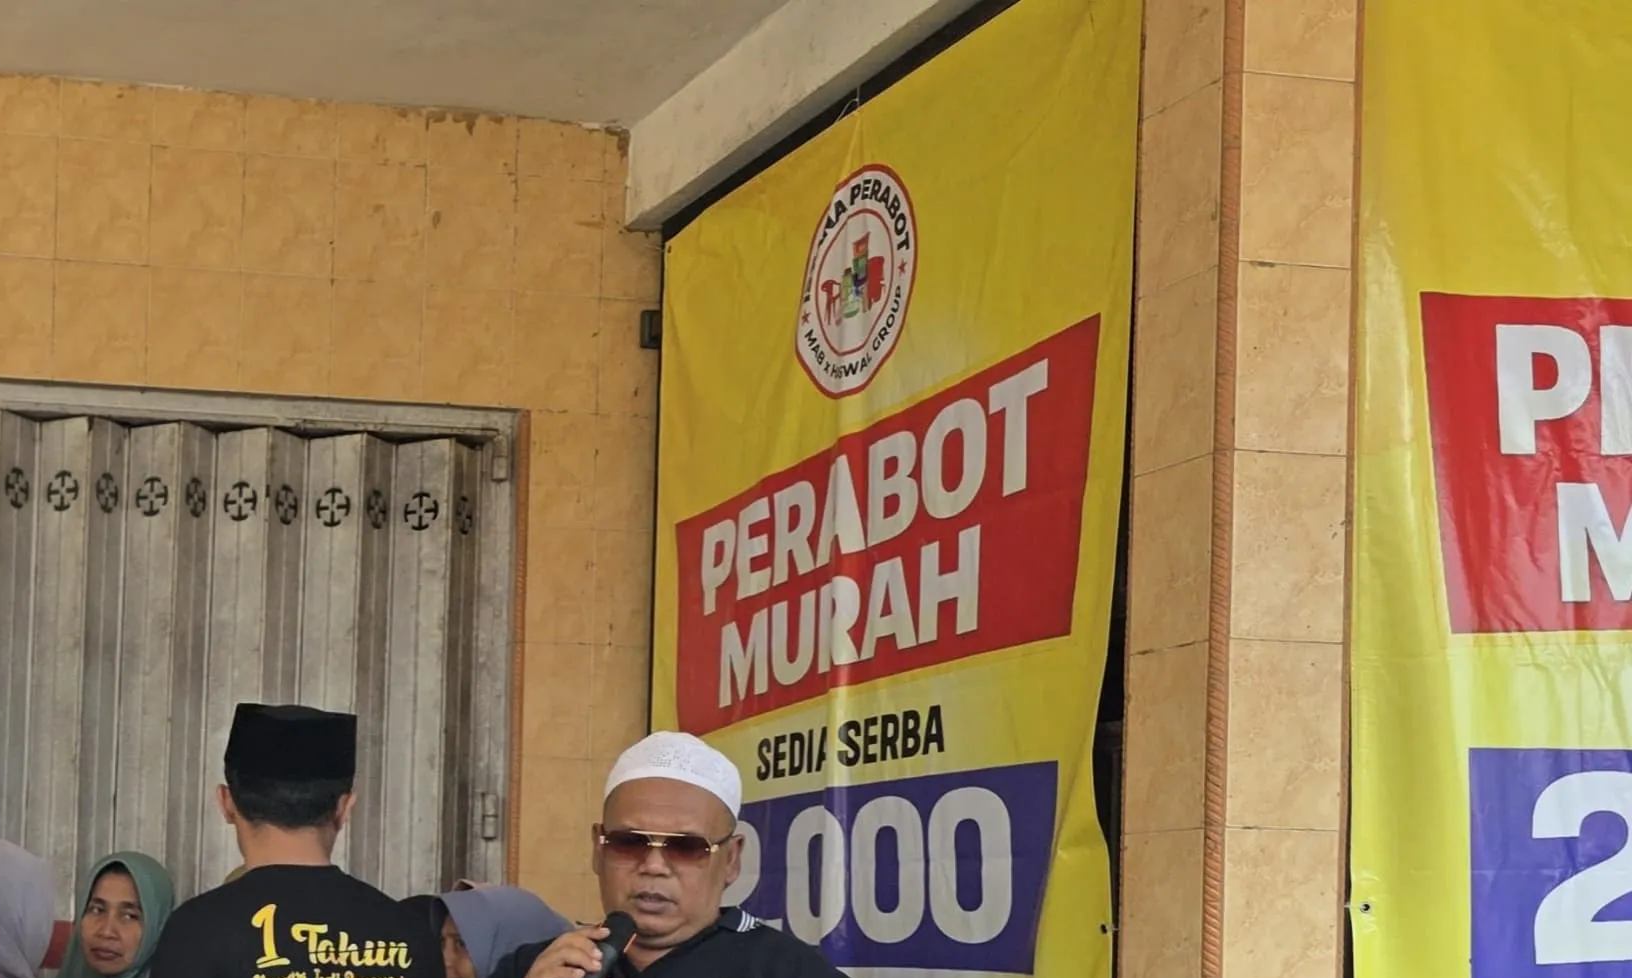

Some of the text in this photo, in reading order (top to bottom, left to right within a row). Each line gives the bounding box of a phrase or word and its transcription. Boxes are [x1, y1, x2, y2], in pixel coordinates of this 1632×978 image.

[850, 179, 912, 251] PERABOT
[804, 328, 825, 366] MAB
[872, 285, 903, 352] GROUP
[701, 358, 1049, 616] PERABOT
[719, 524, 982, 709] MURAH
[837, 704, 945, 767] SERBA
[251, 903, 412, 969] 1 Tahun
